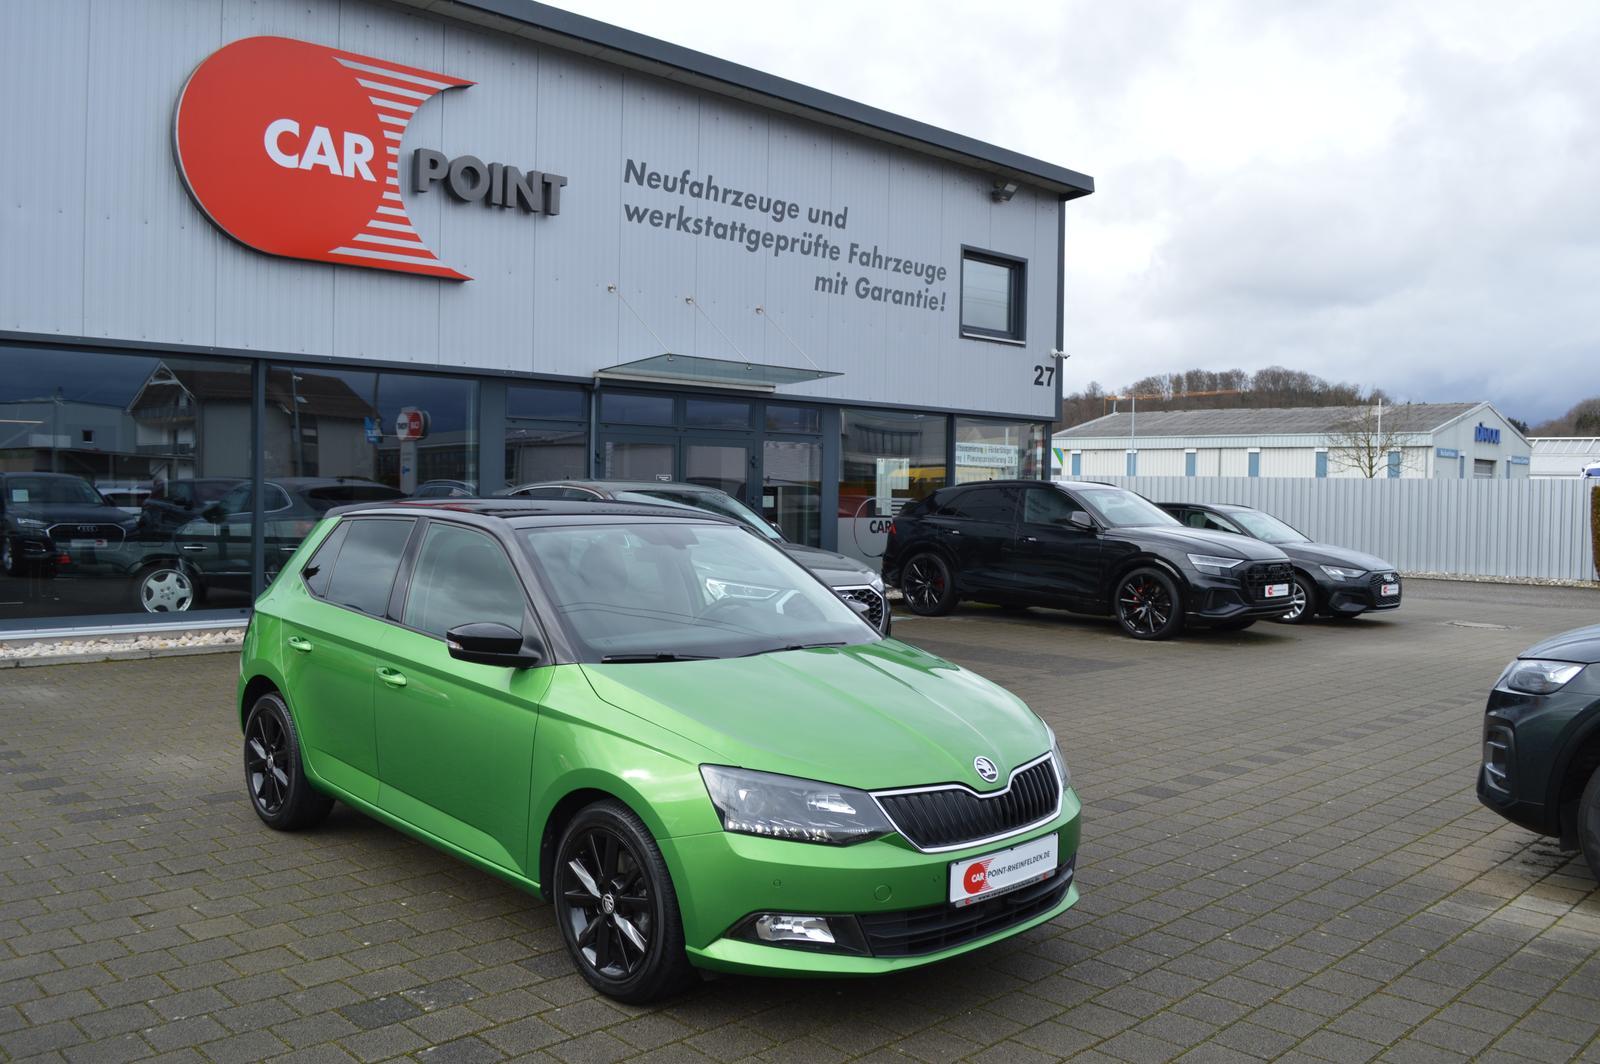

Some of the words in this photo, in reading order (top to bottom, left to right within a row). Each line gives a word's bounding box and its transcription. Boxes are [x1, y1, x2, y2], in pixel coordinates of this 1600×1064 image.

[264, 118, 377, 182] CAR
[413, 148, 567, 216] POINT
[624, 158, 800, 223] Neufahrzeuge
[807, 206, 849, 230] und
[623, 203, 841, 257] werkstattgeprüfte
[848, 242, 947, 286] Fahrzeuge
[814, 271, 849, 296] mit
[855, 276, 947, 312] Garantie!
[1033, 364, 1055, 387] 27
[971, 871, 985, 883] CAR
[987, 850, 1051, 879] POINT-RHEINFELDEN.DE
